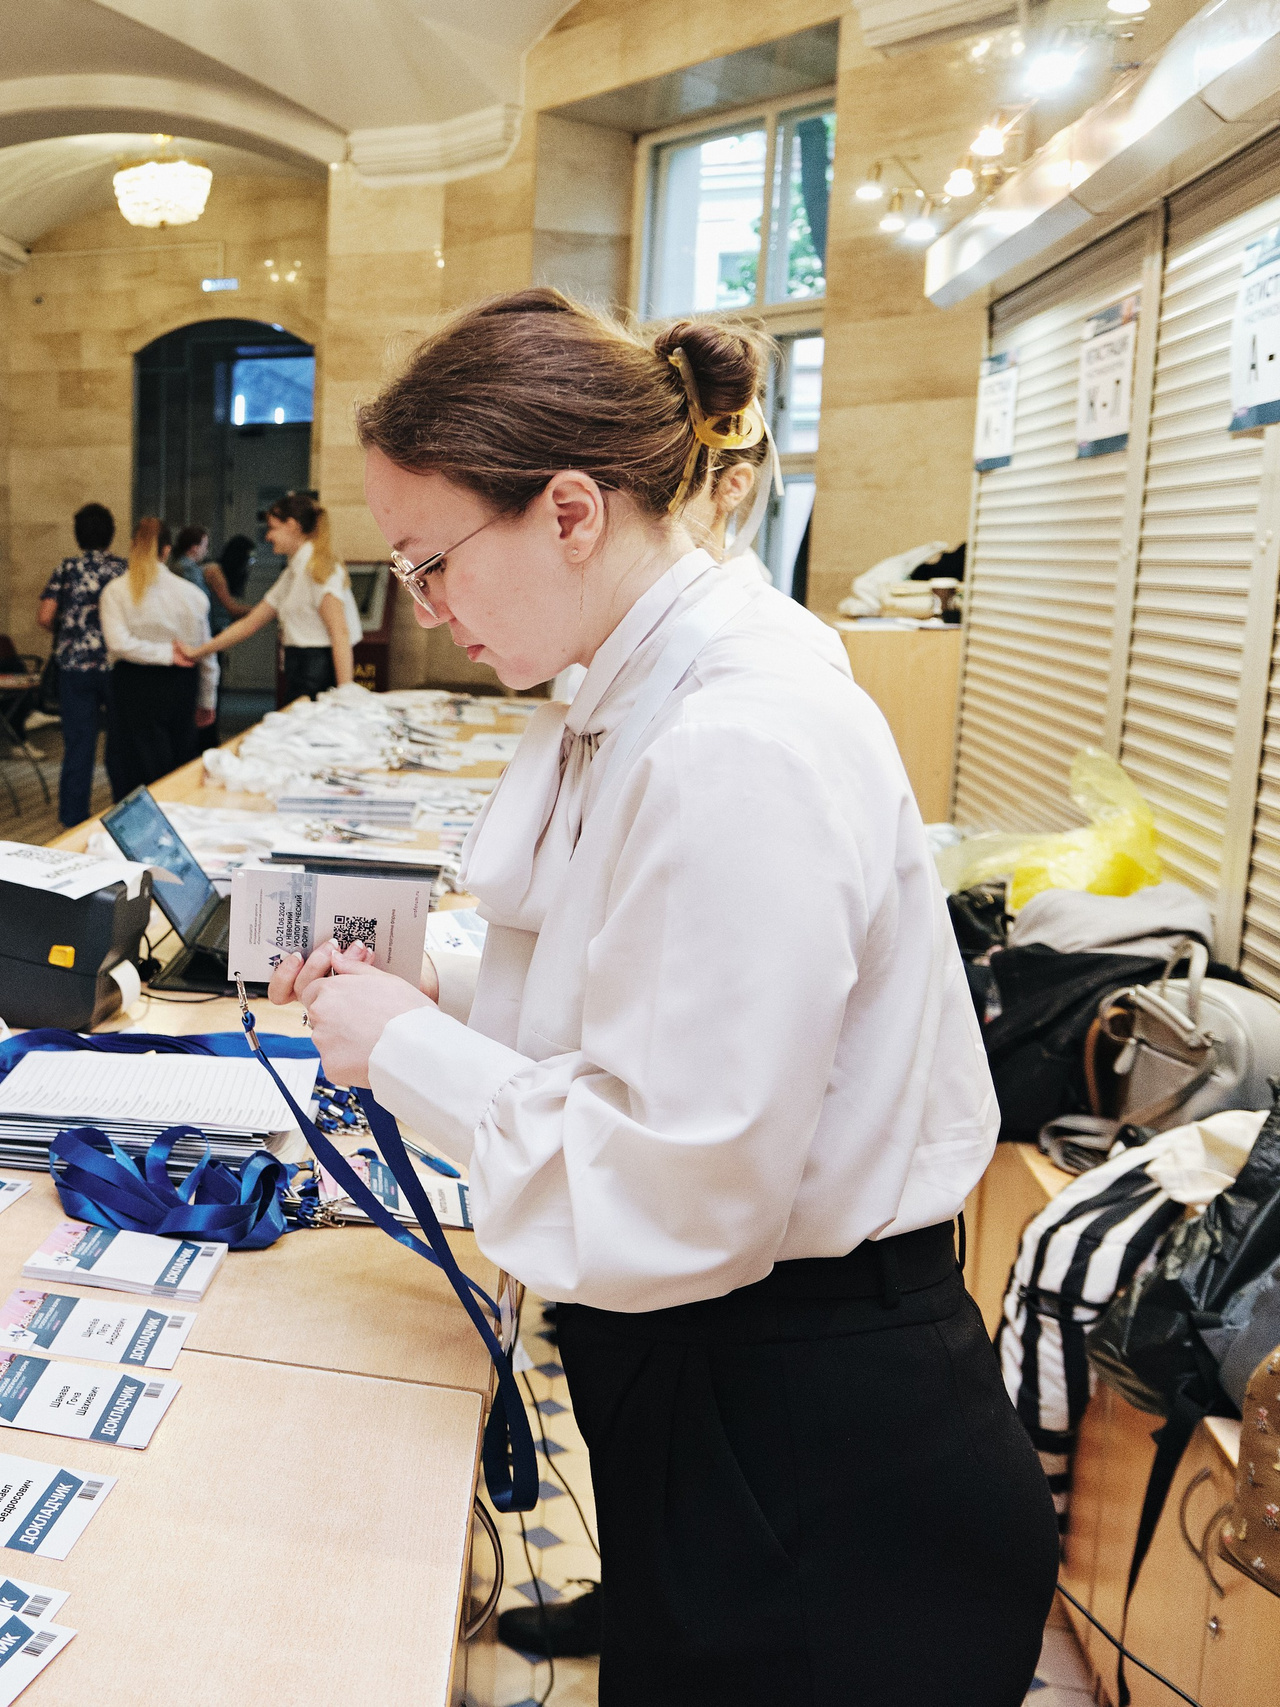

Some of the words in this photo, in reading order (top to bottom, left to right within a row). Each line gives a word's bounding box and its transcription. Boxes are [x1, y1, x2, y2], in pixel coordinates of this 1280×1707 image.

[301, 925, 309, 948] ФОРУМ
[163, 1247, 196, 1285] ДОКЛАДЧИК
[129, 1317, 162, 1361] ДОКЛАДЧИК
[101, 1384, 139, 1436] ДОКЛАДЧИК
[19, 1482, 74, 1546] ДОКЛАДЧИК
